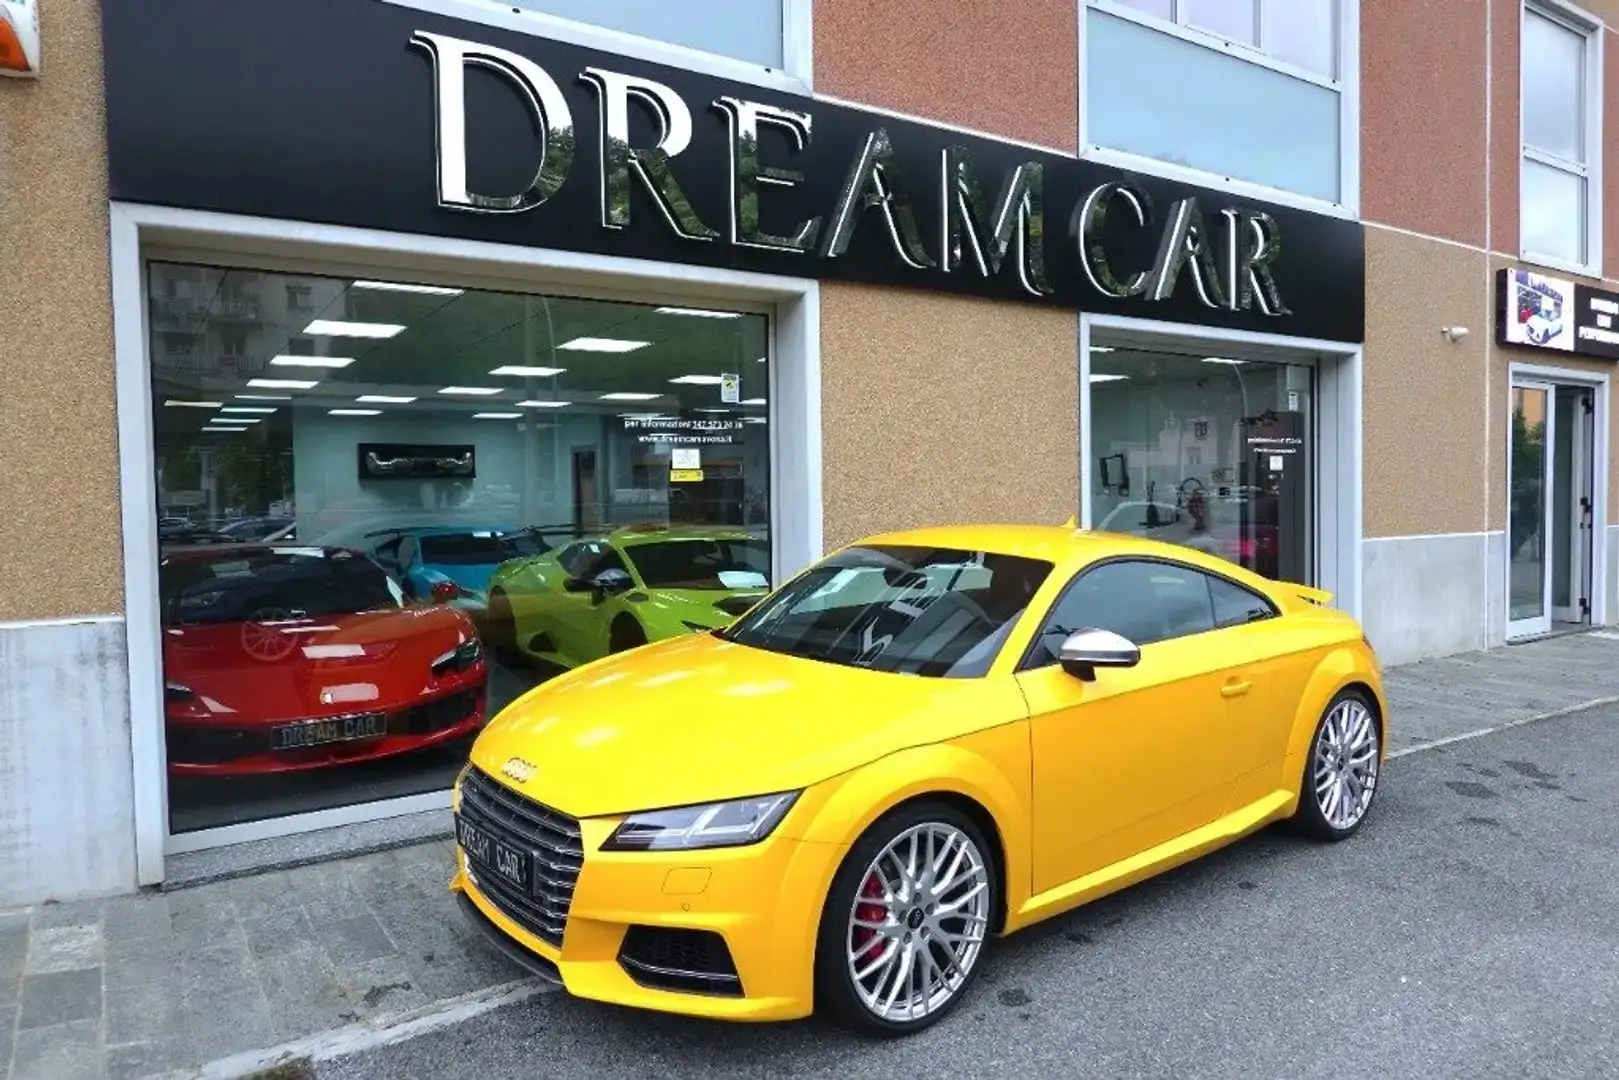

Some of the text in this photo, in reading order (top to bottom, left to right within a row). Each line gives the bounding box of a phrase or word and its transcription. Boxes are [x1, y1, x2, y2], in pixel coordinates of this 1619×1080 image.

[409, 30, 1293, 317] DREAM CAR
[624, 421, 639, 429] per
[281, 716, 377, 746] DREAM CAR
[460, 819, 521, 884] DREAM CAR
